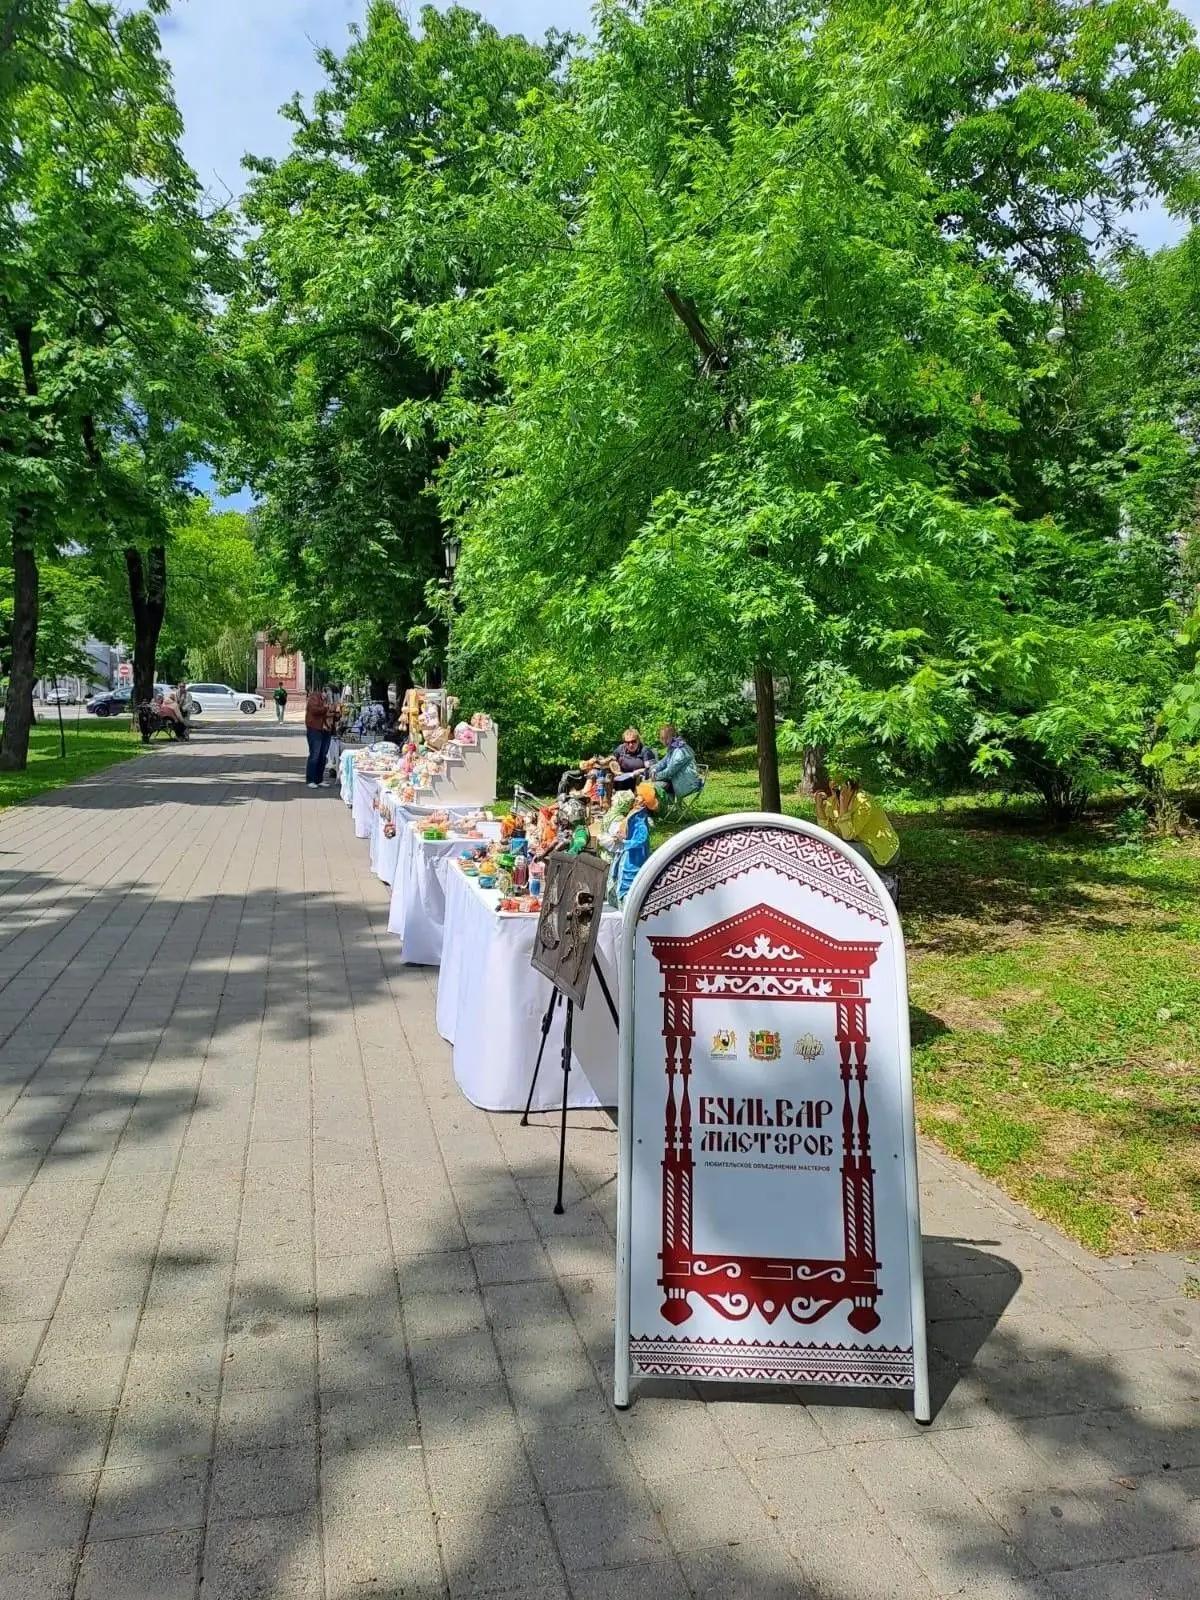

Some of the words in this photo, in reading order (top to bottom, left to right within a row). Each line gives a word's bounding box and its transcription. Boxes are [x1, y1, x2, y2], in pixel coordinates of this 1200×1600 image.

[699, 1097, 833, 1128] БУЛЬВАР
[700, 1131, 833, 1156] МАСТЕРОВ
[704, 1160, 752, 1169] ЛЮБИТЕЛЬСКОЕ
[753, 1162, 797, 1171] ОБЪЕДИНЕНИЕ
